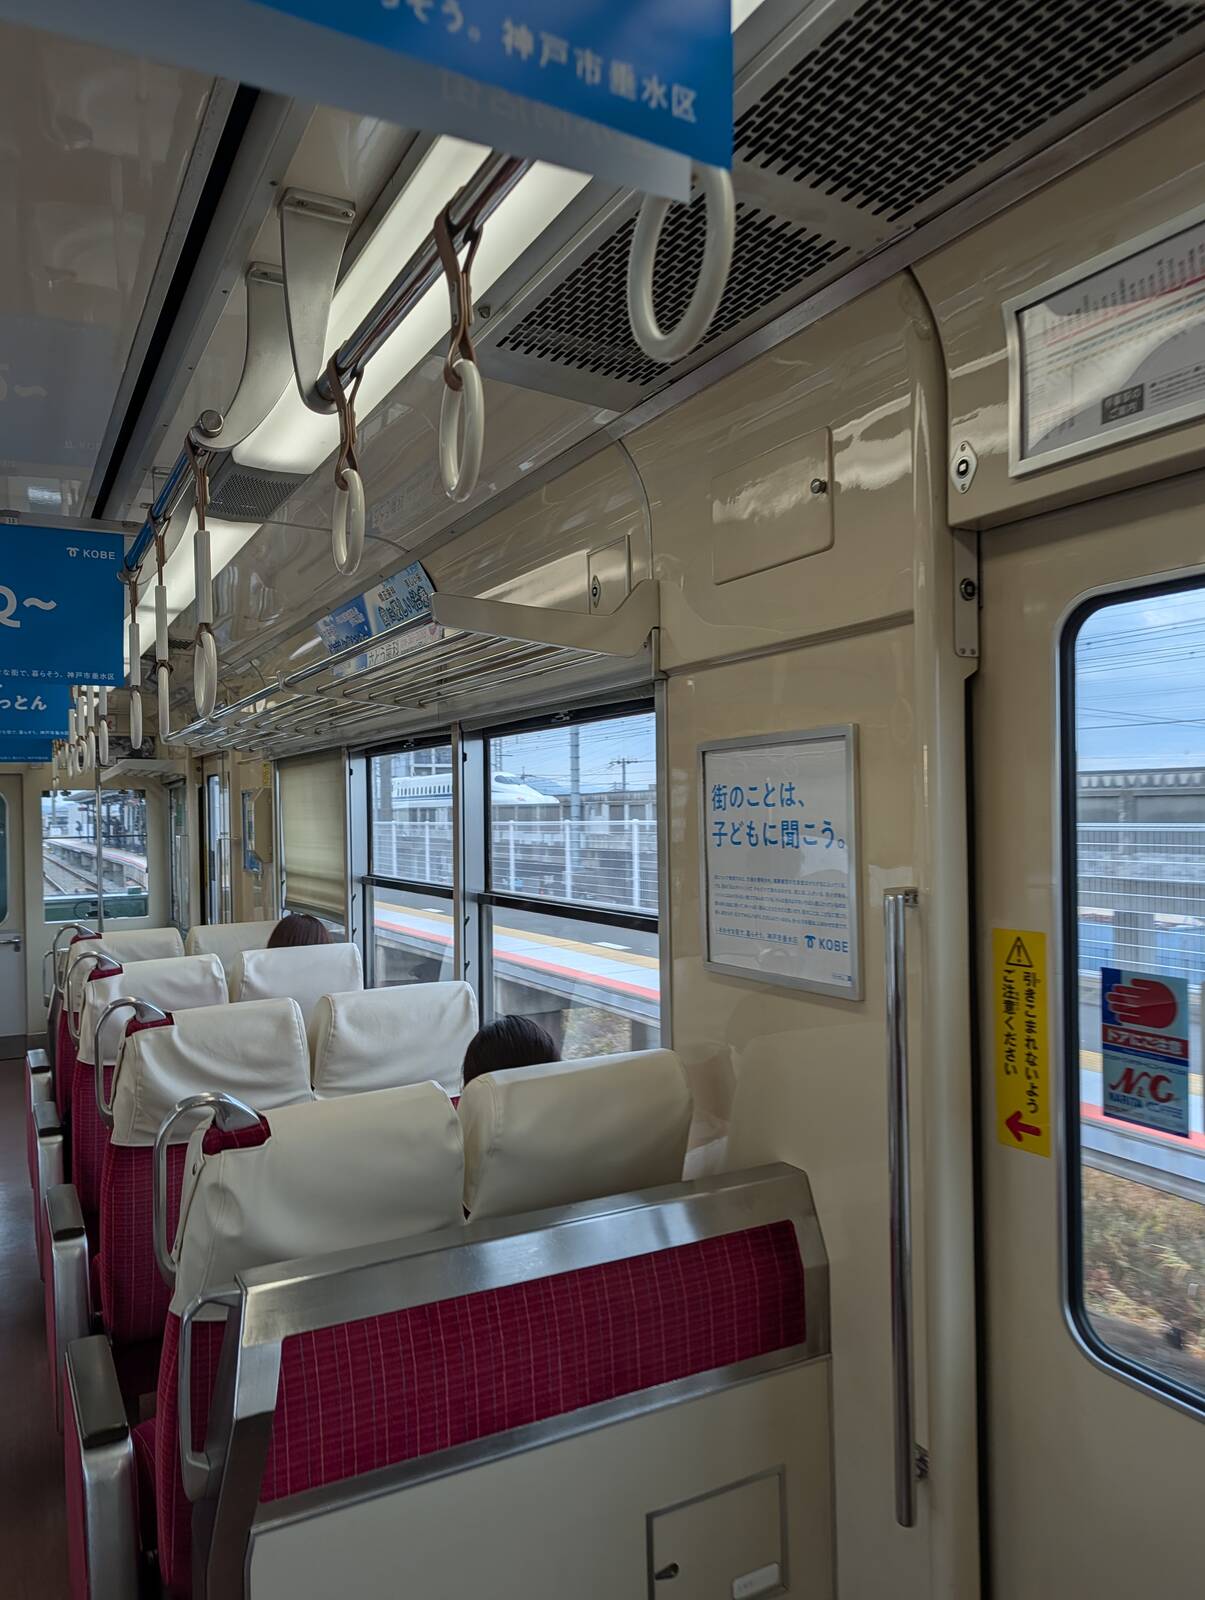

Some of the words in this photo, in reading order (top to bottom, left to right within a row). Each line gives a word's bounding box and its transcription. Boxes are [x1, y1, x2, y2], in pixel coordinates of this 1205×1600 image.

[82, 548, 116, 560] KOBE
[711, 781, 805, 812] 街のことは、
[711, 819, 846, 850] 子どもに聞こう。
[818, 937, 849, 954] KOBE
[1001, 969, 1018, 1076] ご注意ください
